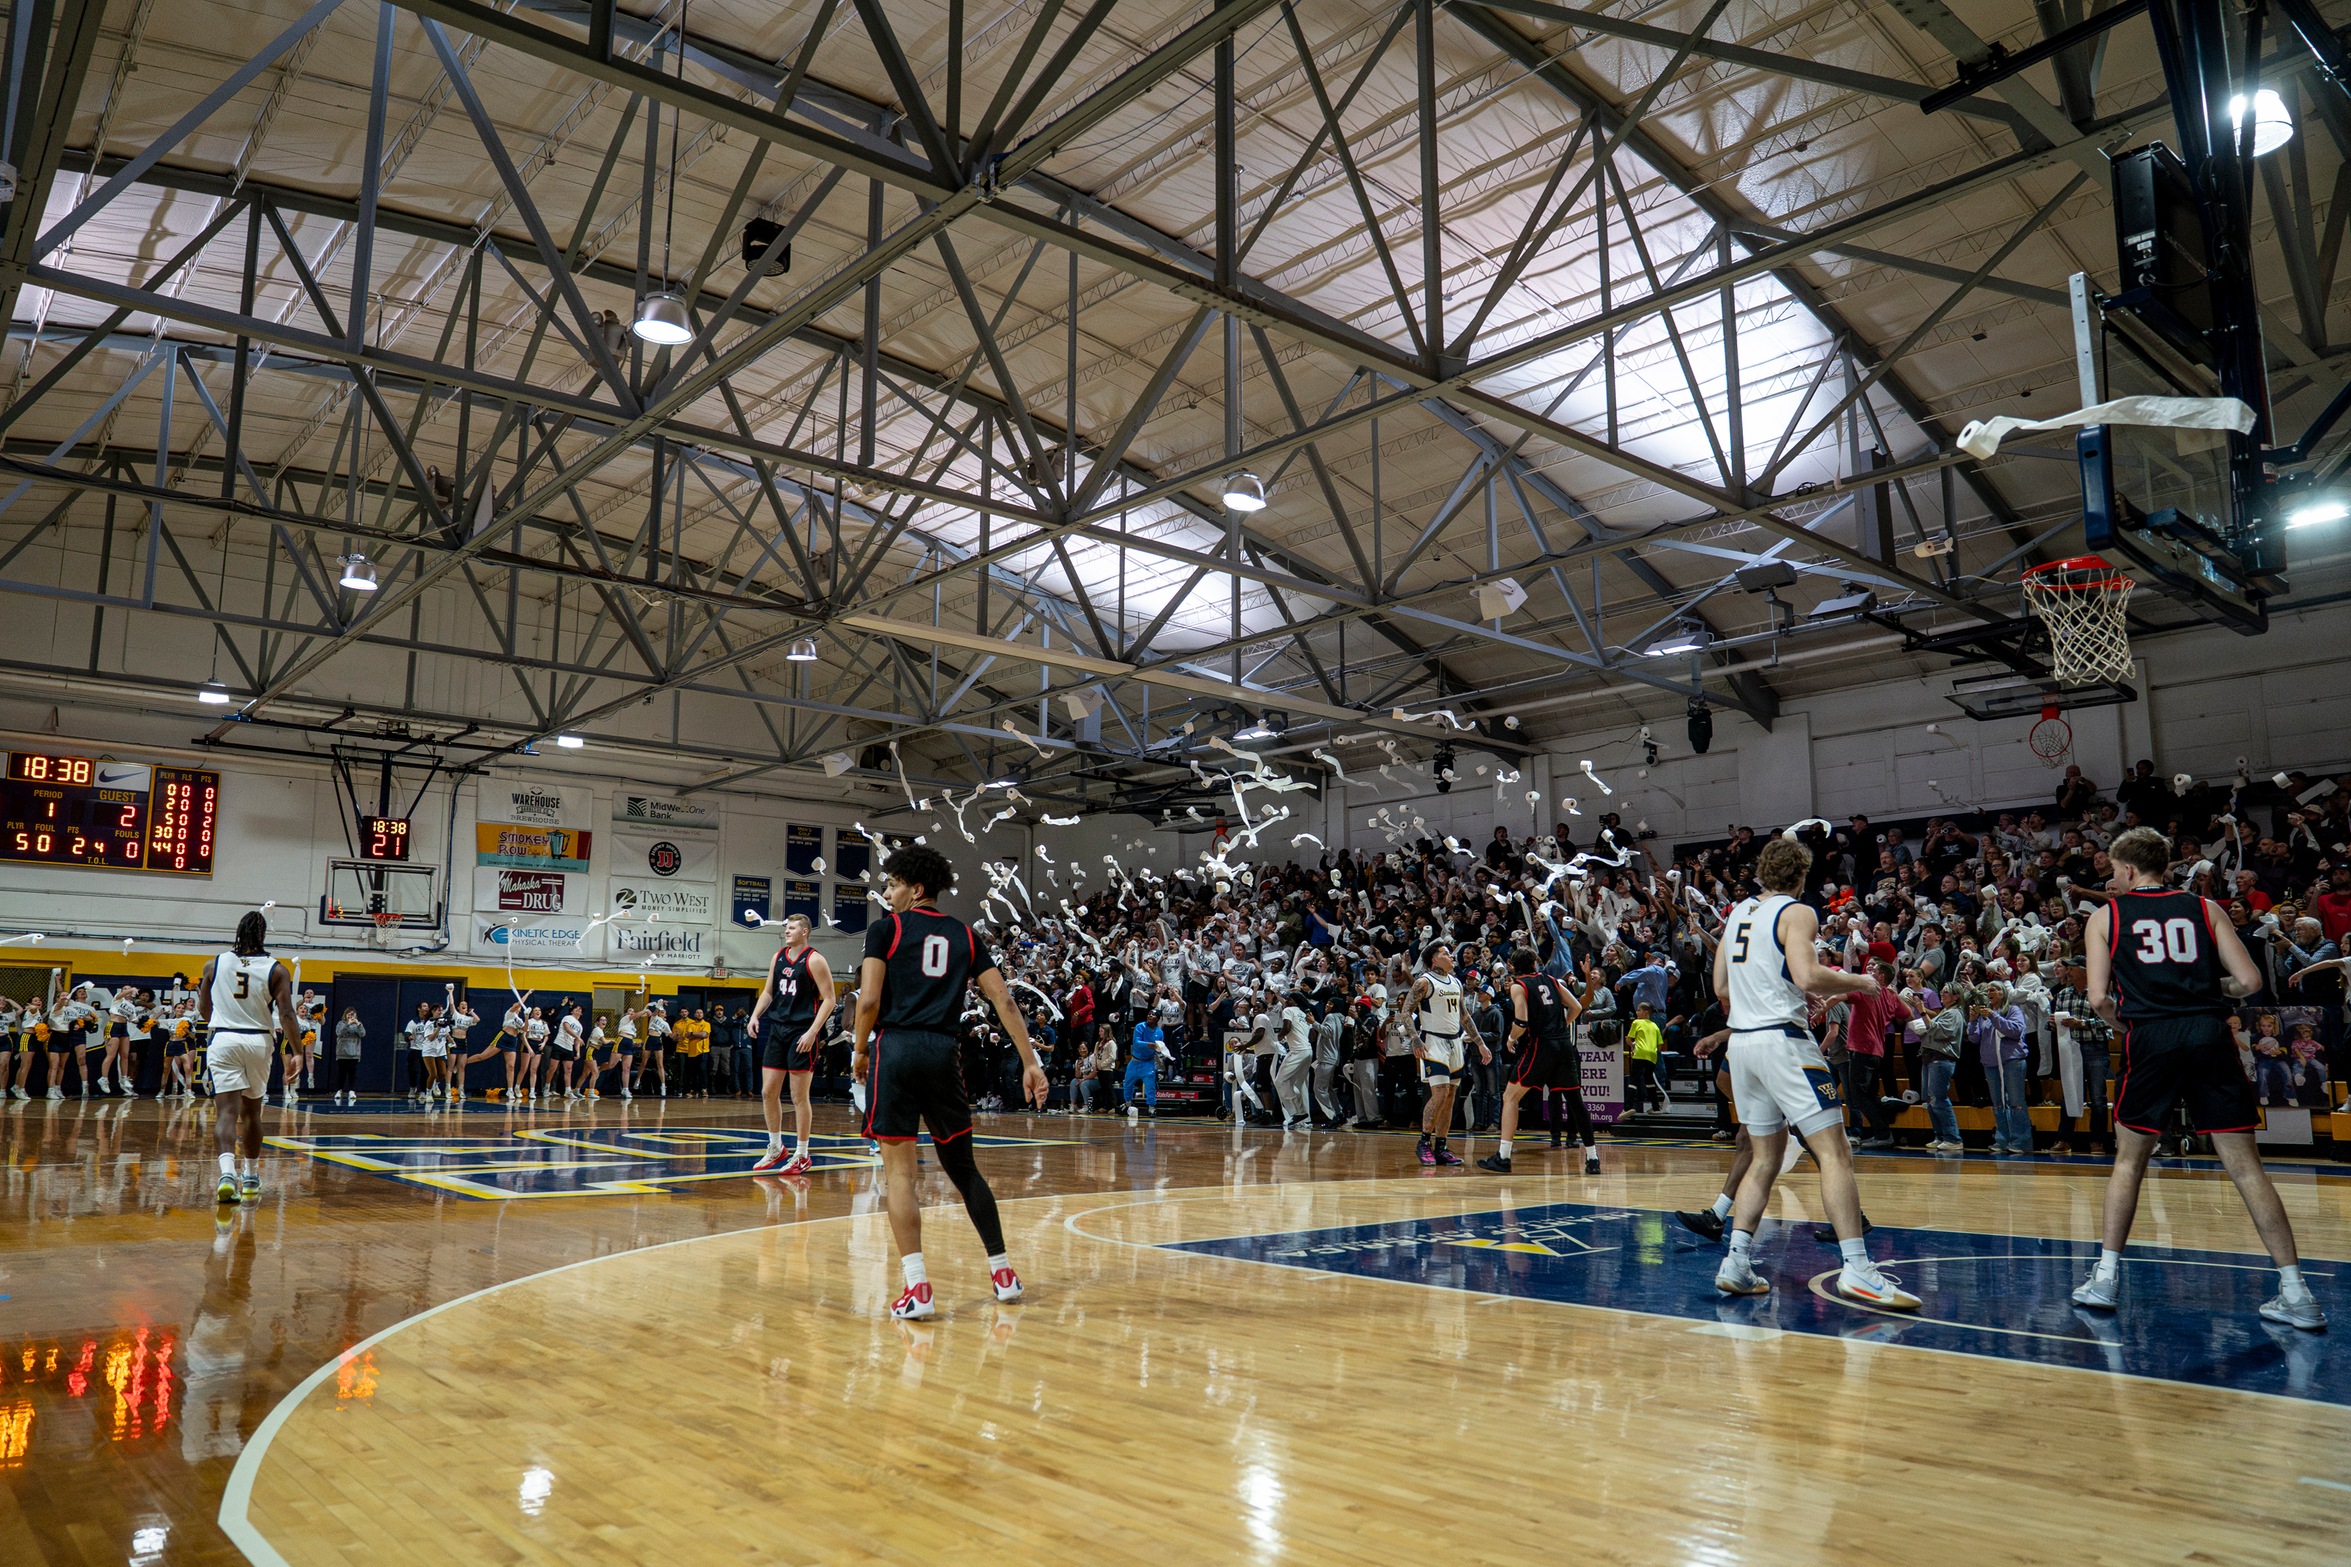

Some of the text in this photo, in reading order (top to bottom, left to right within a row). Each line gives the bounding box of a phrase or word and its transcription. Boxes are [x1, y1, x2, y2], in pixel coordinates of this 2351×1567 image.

[24, 757, 89, 783] 18:38
[33, 789, 136, 802] PERIOD GUEST
[167, 784, 214, 799] 0 0 0
[166, 797, 213, 813] 2 0 0
[512, 793, 560, 808] WAREHOUSE
[651, 802, 705, 815] MidWeOne
[48, 802, 136, 827] 1 2
[165, 812, 211, 828] 5 0 2
[511, 815, 559, 824] BREWHOUSE
[650, 810, 674, 820] Bank.
[7, 821, 140, 839] PLYR FOUL PTS FOULS
[155, 826, 210, 842] 30 0 0
[372, 820, 407, 835] 18:38
[372, 834, 401, 856] 21
[498, 831, 550, 846] SMOKEY
[72, 837, 85, 855] 2
[94, 842, 105, 853] 4
[126, 841, 139, 859] 0
[152, 841, 209, 857] 44 0 0
[497, 844, 527, 857] ROW
[87, 857, 109, 865] T.O.L.
[175, 856, 184, 869] 0
[657, 851, 673, 867] JJ
[500, 872, 541, 893] Mahaska
[737, 879, 767, 887] SOFTBALL
[522, 892, 562, 911] DRUG
[668, 906, 707, 914] SIMPLIFIED
[552, 930, 581, 939] EDGE
[617, 929, 701, 952] Fairfield
[2132, 918, 2198, 964] 30
[1732, 922, 1752, 964] 5
[922, 934, 949, 977] 0
[233, 971, 249, 999] 3
[779, 978, 797, 996] 44
[1538, 984, 1553, 1005] 2
[1447, 998, 1458, 1013] 14
[1579, 1051, 1615, 1062] TEAM
[1580, 1068, 1607, 1079] ERE
[1581, 1085, 1610, 1096] YOU!
[1817, 1082, 1837, 1100] WP
